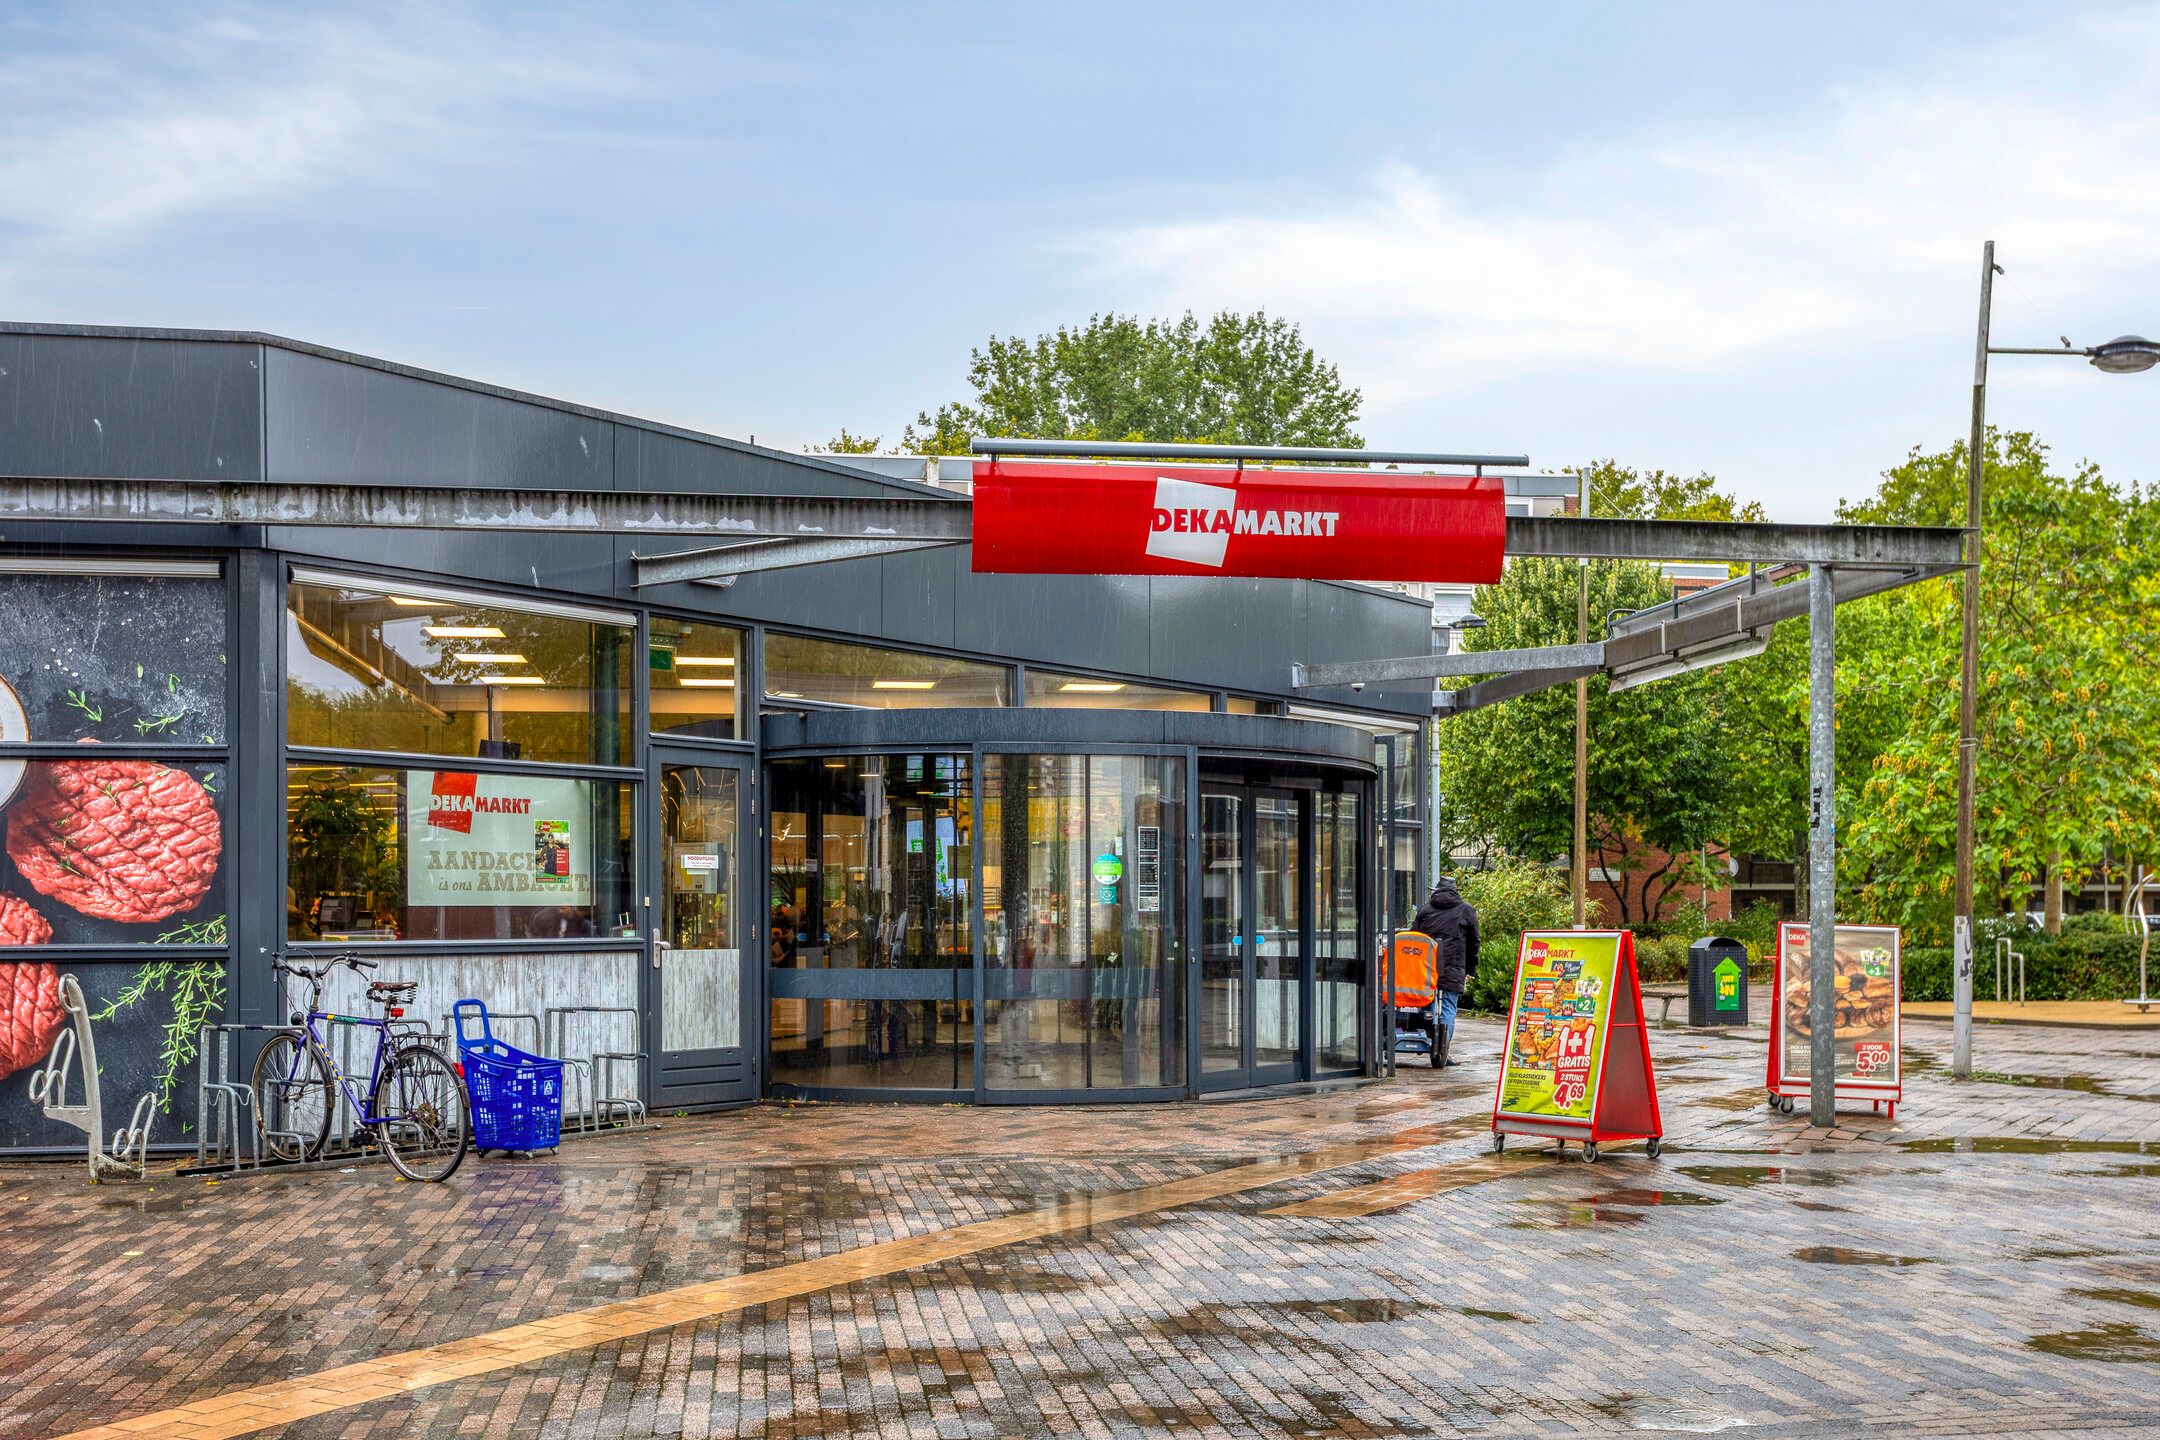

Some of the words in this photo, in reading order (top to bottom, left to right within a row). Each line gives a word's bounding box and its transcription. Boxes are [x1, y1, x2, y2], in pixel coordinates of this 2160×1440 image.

[1152, 507, 1339, 537] DEKAMARKT
[429, 794, 532, 815] DEKAMARKT
[438, 876, 449, 891] is
[452, 881, 472, 891] ons
[1528, 948, 1576, 959] DEKAMARKT
[1578, 999, 1591, 1011] +2
[1558, 1024, 1597, 1057] 1+1
[1557, 1055, 1592, 1069] GRATIS
[1565, 1073, 1585, 1082] STUKS
